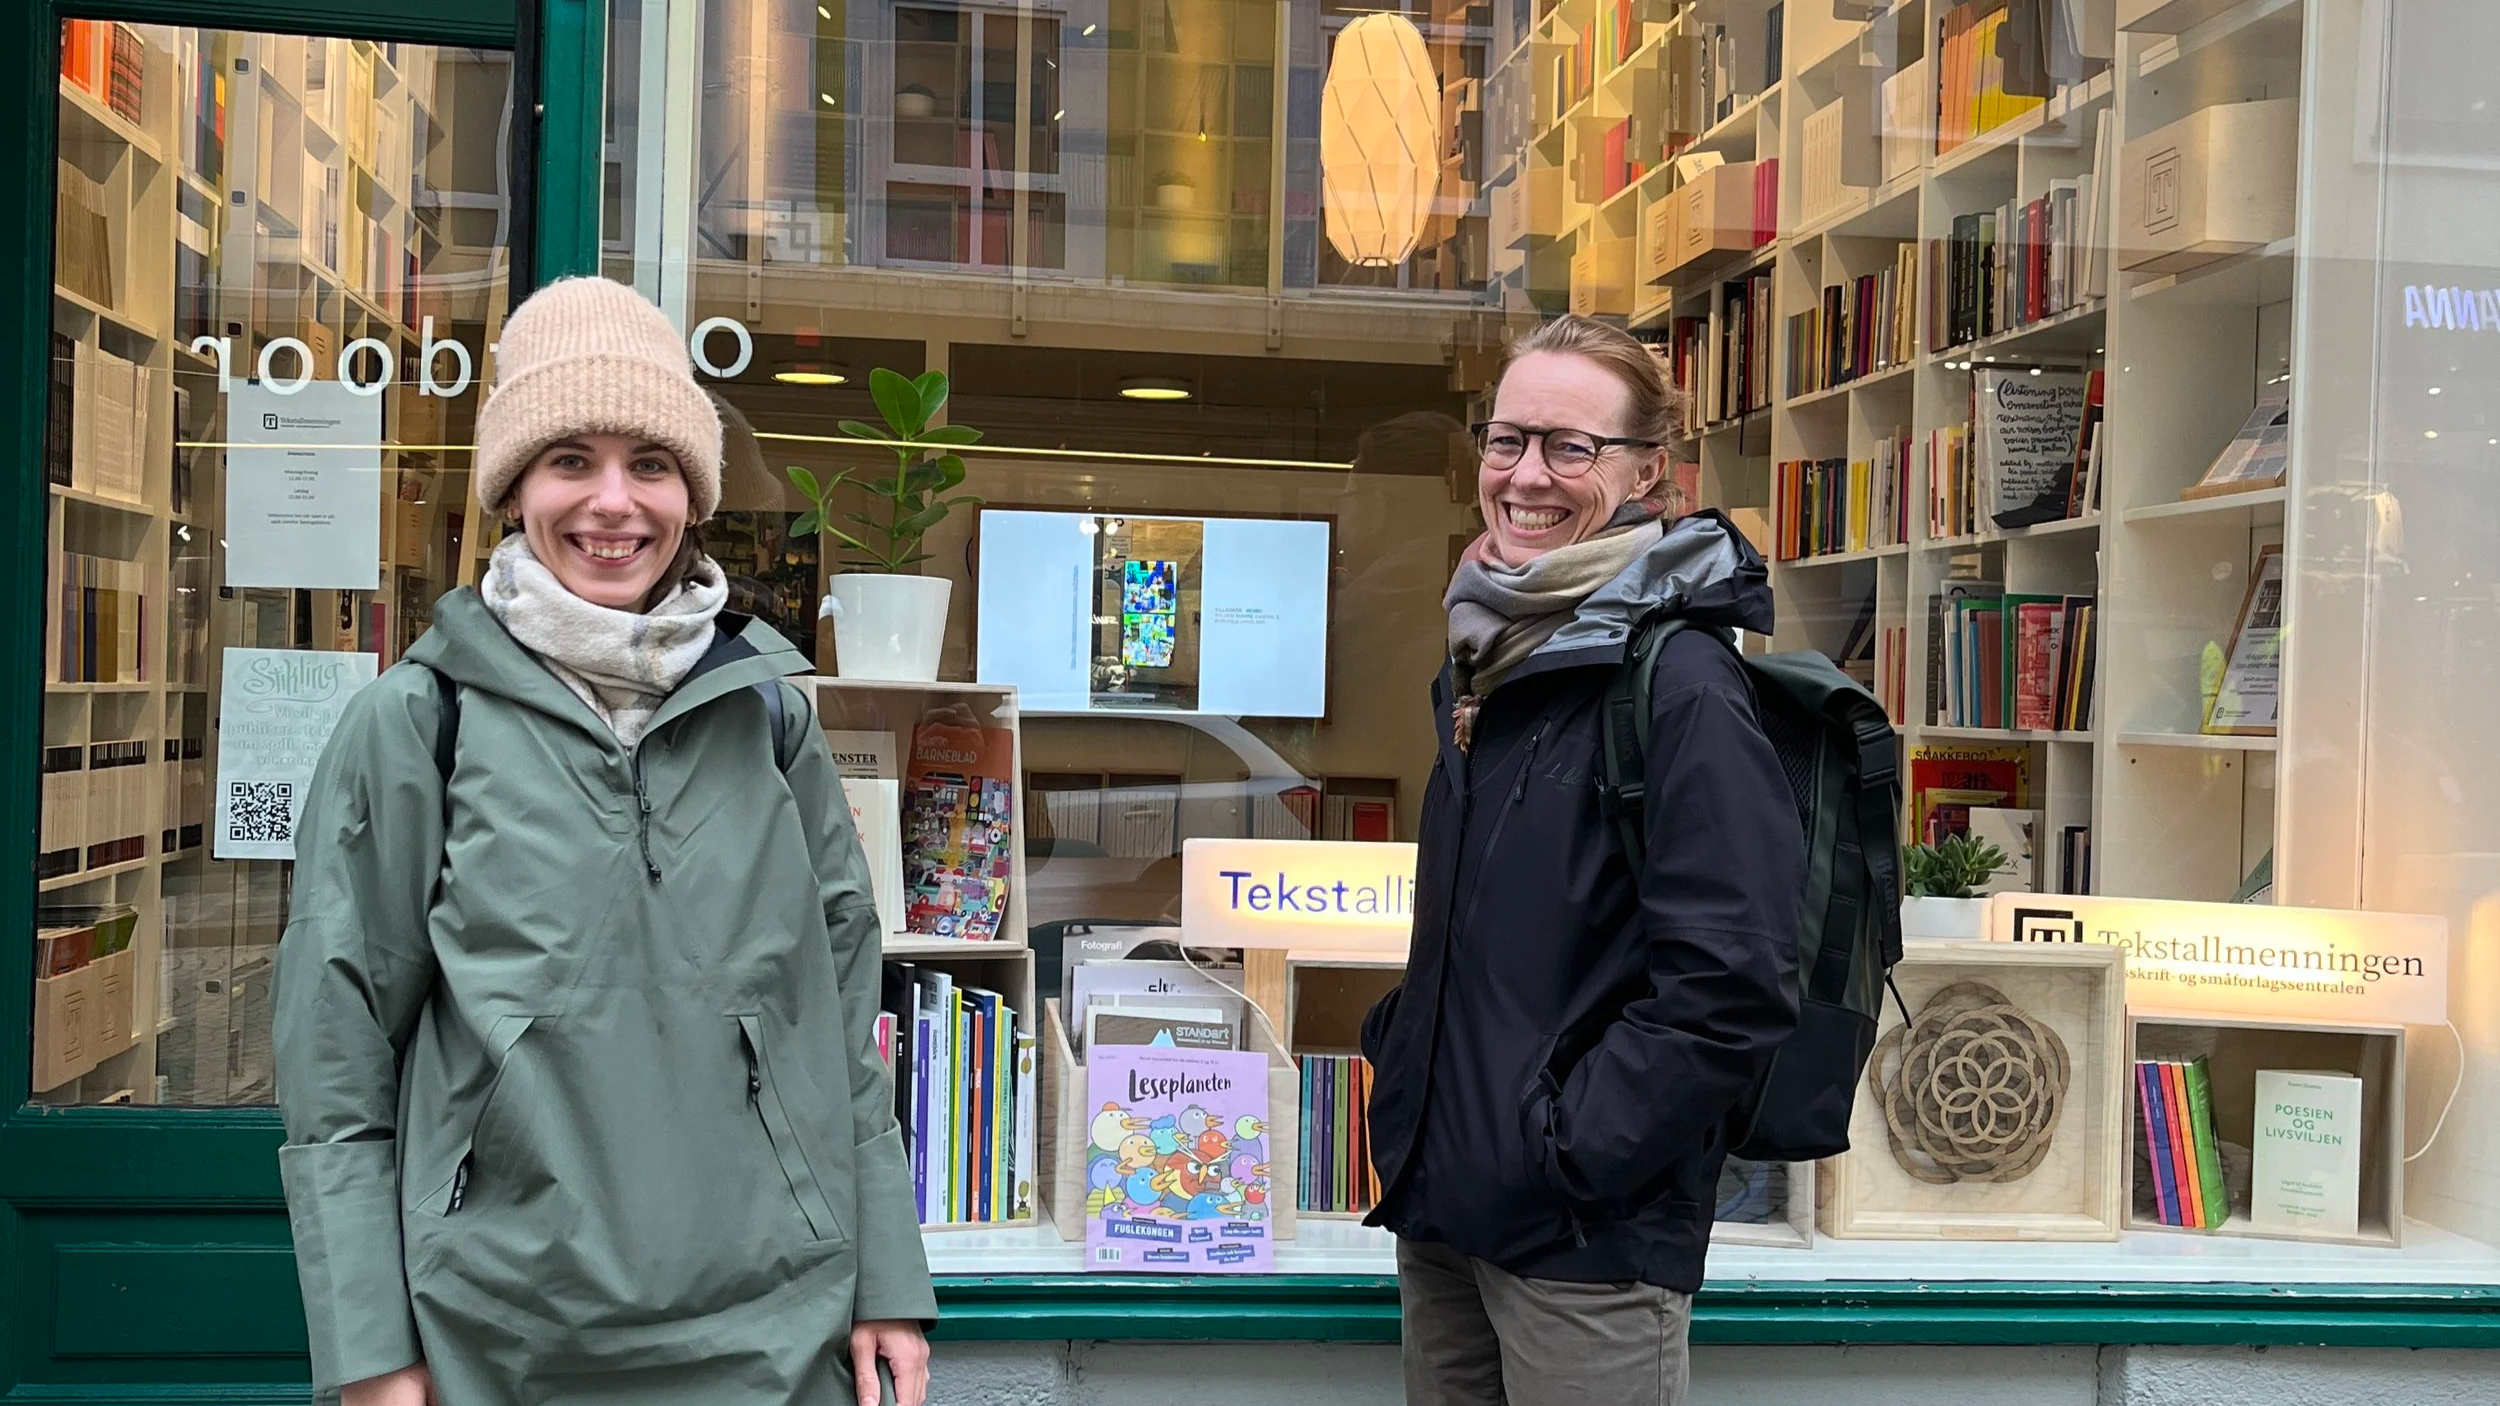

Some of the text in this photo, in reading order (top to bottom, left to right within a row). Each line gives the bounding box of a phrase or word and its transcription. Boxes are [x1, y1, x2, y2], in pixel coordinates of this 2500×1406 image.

[243, 656, 345, 701] Stikling
[916, 747, 977, 764] BARNEBLAD
[1081, 940, 1123, 952] Fotografi
[2098, 930, 2424, 982] Tekstallmenningen
[2124, 966, 2365, 996] sskrift- og småforlagssentralen
[1176, 1026, 1229, 1039] STANDart
[1129, 1068, 1231, 1103] Leseplaneten
[2275, 1104, 2333, 1120] POESIEN
[2293, 1118, 2314, 1130] OG
[2265, 1127, 2342, 1146] LIVSVILJEN
[1114, 1223, 1174, 1238] FUGLEKONGEN
